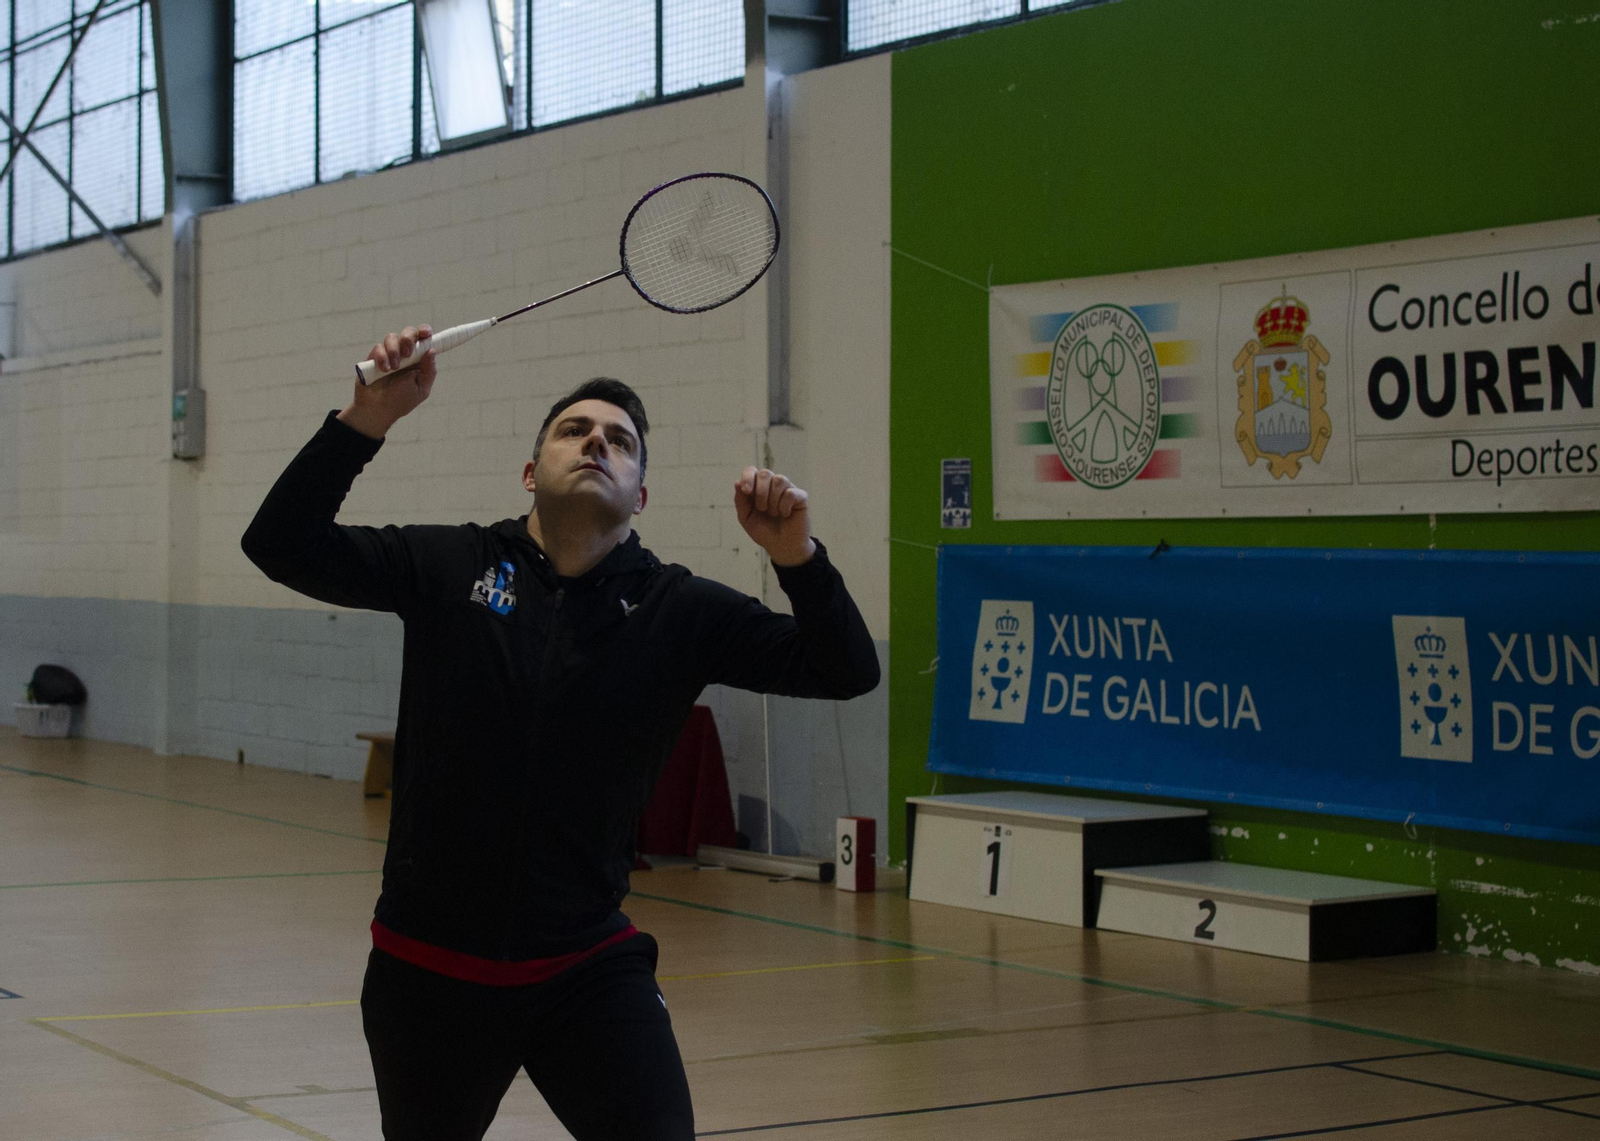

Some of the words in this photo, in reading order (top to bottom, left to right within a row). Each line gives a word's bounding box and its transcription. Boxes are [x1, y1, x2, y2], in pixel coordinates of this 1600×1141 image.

[1368, 269, 1550, 332] Concello
[1567, 262, 1600, 315] d
[1059, 310, 1124, 354] MUNICIPAL
[1125, 324, 1143, 350] DE
[1137, 349, 1157, 457] DEPORTES
[1368, 341, 1597, 421] OUREN
[1051, 357, 1074, 460] CONSELLO
[1451, 438, 1598, 487] Deportes
[1049, 613, 1174, 663] XUNTA
[1488, 631, 1599, 687] XUN
[1042, 672, 1093, 718] DE
[1102, 675, 1262, 732] GALICIA
[1492, 701, 1555, 755] DE
[841, 834, 853, 865] 3
[987, 841, 1001, 896] 1
[1194, 899, 1217, 940] 2
